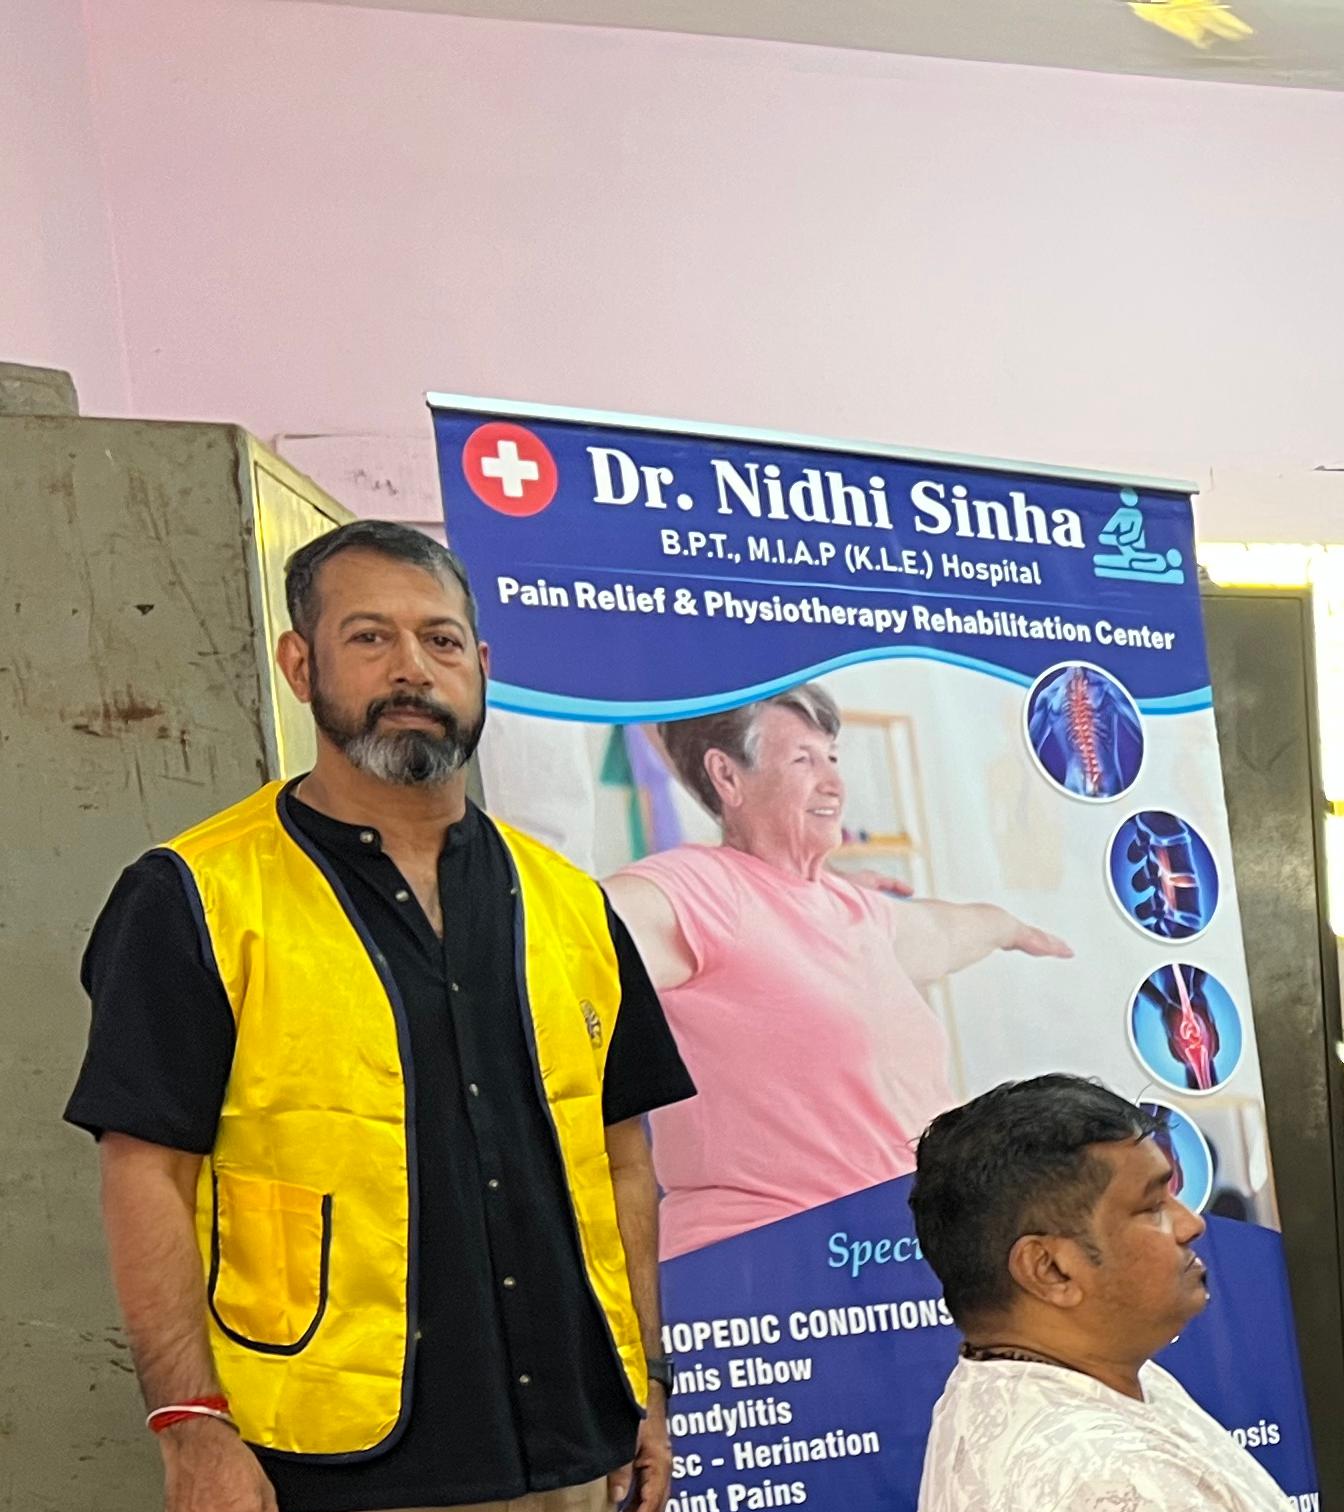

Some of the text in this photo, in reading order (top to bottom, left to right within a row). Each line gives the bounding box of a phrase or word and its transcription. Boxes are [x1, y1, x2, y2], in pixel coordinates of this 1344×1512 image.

[586, 446, 1086, 549] Dr. Nidhi Sinha
[660, 529, 1042, 587] B.P.T., M.I.A.P (K.L.E.) Hospital
[497, 577, 1176, 650] Pain Relief & Physiotherapy Rehabilitation Center
[789, 1297, 955, 1341] CONDITIONS
[728, 1357, 813, 1389] Elbow
[666, 1397, 793, 1438] ondylitis
[733, 1429, 880, 1471] Herination
[727, 1479, 807, 1512] Pains
